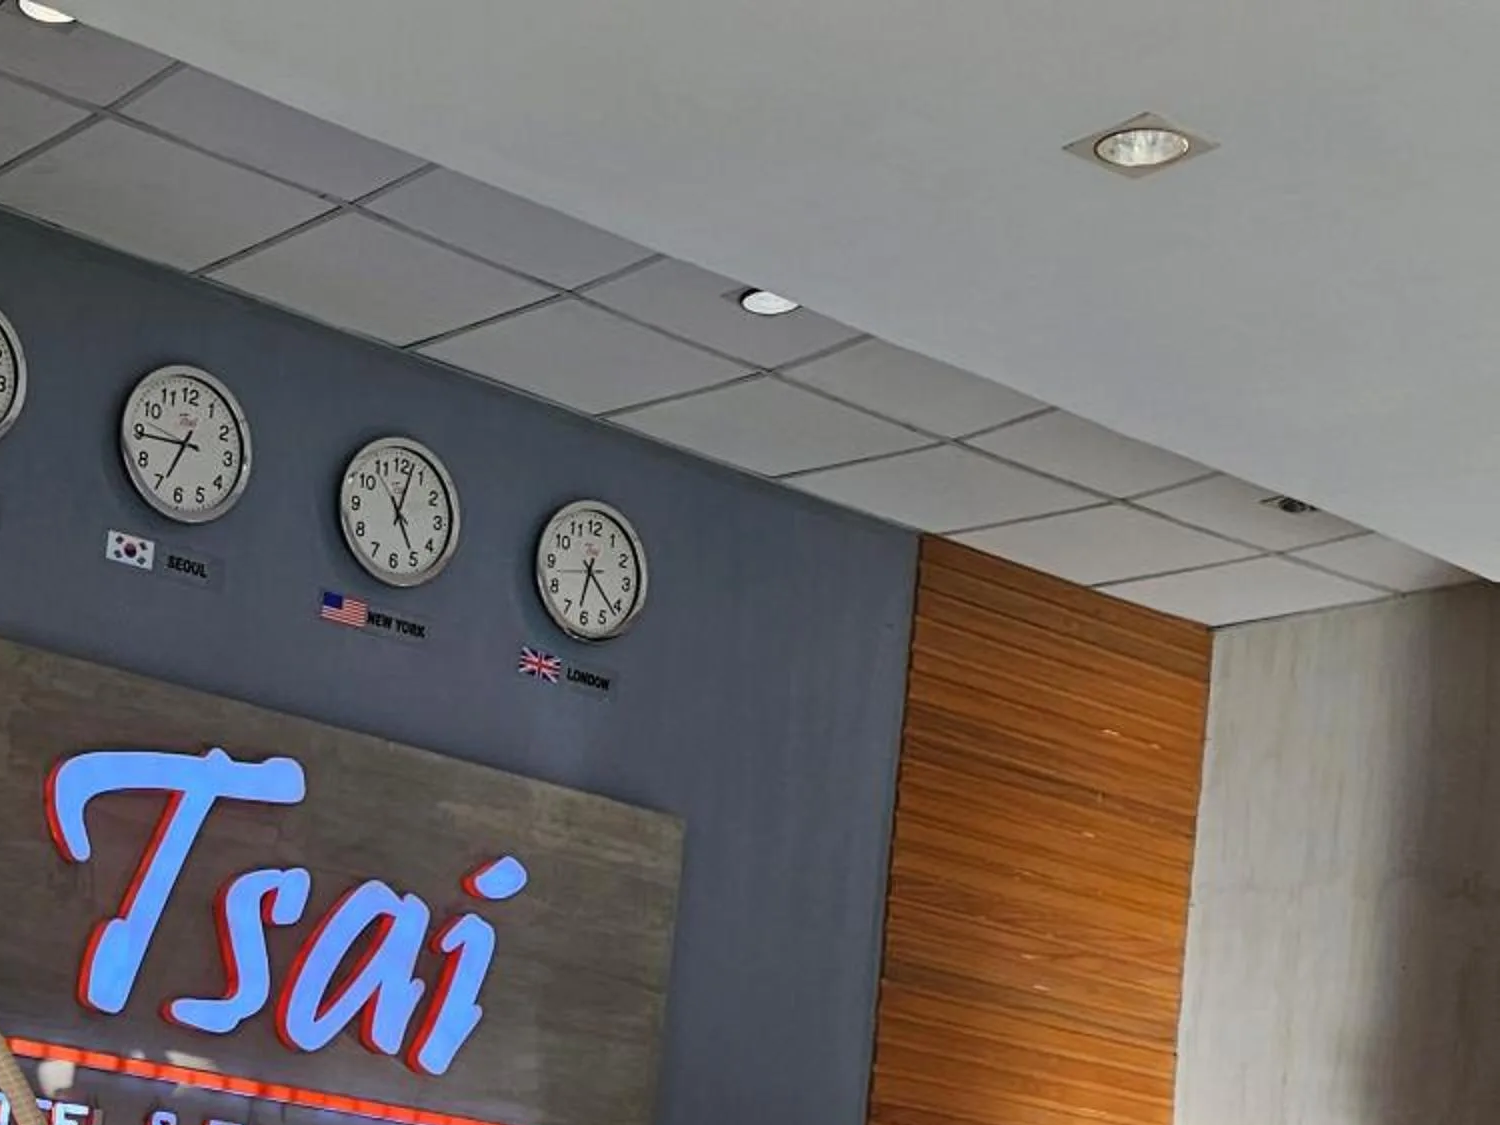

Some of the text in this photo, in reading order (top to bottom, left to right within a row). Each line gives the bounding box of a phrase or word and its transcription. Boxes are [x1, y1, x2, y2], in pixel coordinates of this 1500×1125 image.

[162, 388, 177, 406] 11
[183, 387, 199, 407] 12
[145, 401, 162, 419] 10
[209, 402, 215, 418] 1
[133, 423, 145, 441] 9
[219, 425, 229, 442] 2
[137, 451, 148, 468] 8
[223, 451, 232, 467] 3
[393, 457, 409, 475] 12
[375, 459, 389, 476] 11
[154, 473, 164, 490] 7
[213, 475, 222, 490] 4
[360, 473, 376, 490] 10
[418, 471, 423, 486] 1
[173, 487, 183, 503] 6
[195, 486, 205, 503] 5
[429, 490, 438, 506] 2
[351, 495, 361, 511] 9
[355, 521, 365, 537] 8
[433, 515, 443, 531] 3
[570, 521, 583, 537] 11
[588, 520, 603, 536] 12
[425, 538, 433, 553] 4
[556, 533, 571, 550] 10
[610, 533, 615, 548] 1
[371, 541, 380, 558] 7
[167, 555, 207, 579] SEOUL
[389, 553, 398, 569] 6
[409, 551, 418, 567] 5
[547, 553, 556, 568] 9
[619, 553, 628, 568] 2
[550, 578, 559, 594] 8
[622, 577, 631, 592] 3
[564, 599, 572, 614] 7
[367, 611, 426, 638] NEW YORK
[580, 611, 588, 625] 6
[597, 610, 607, 624] 5
[566, 667, 610, 690] LONDON
[46, 747, 528, 1075] Tsai
